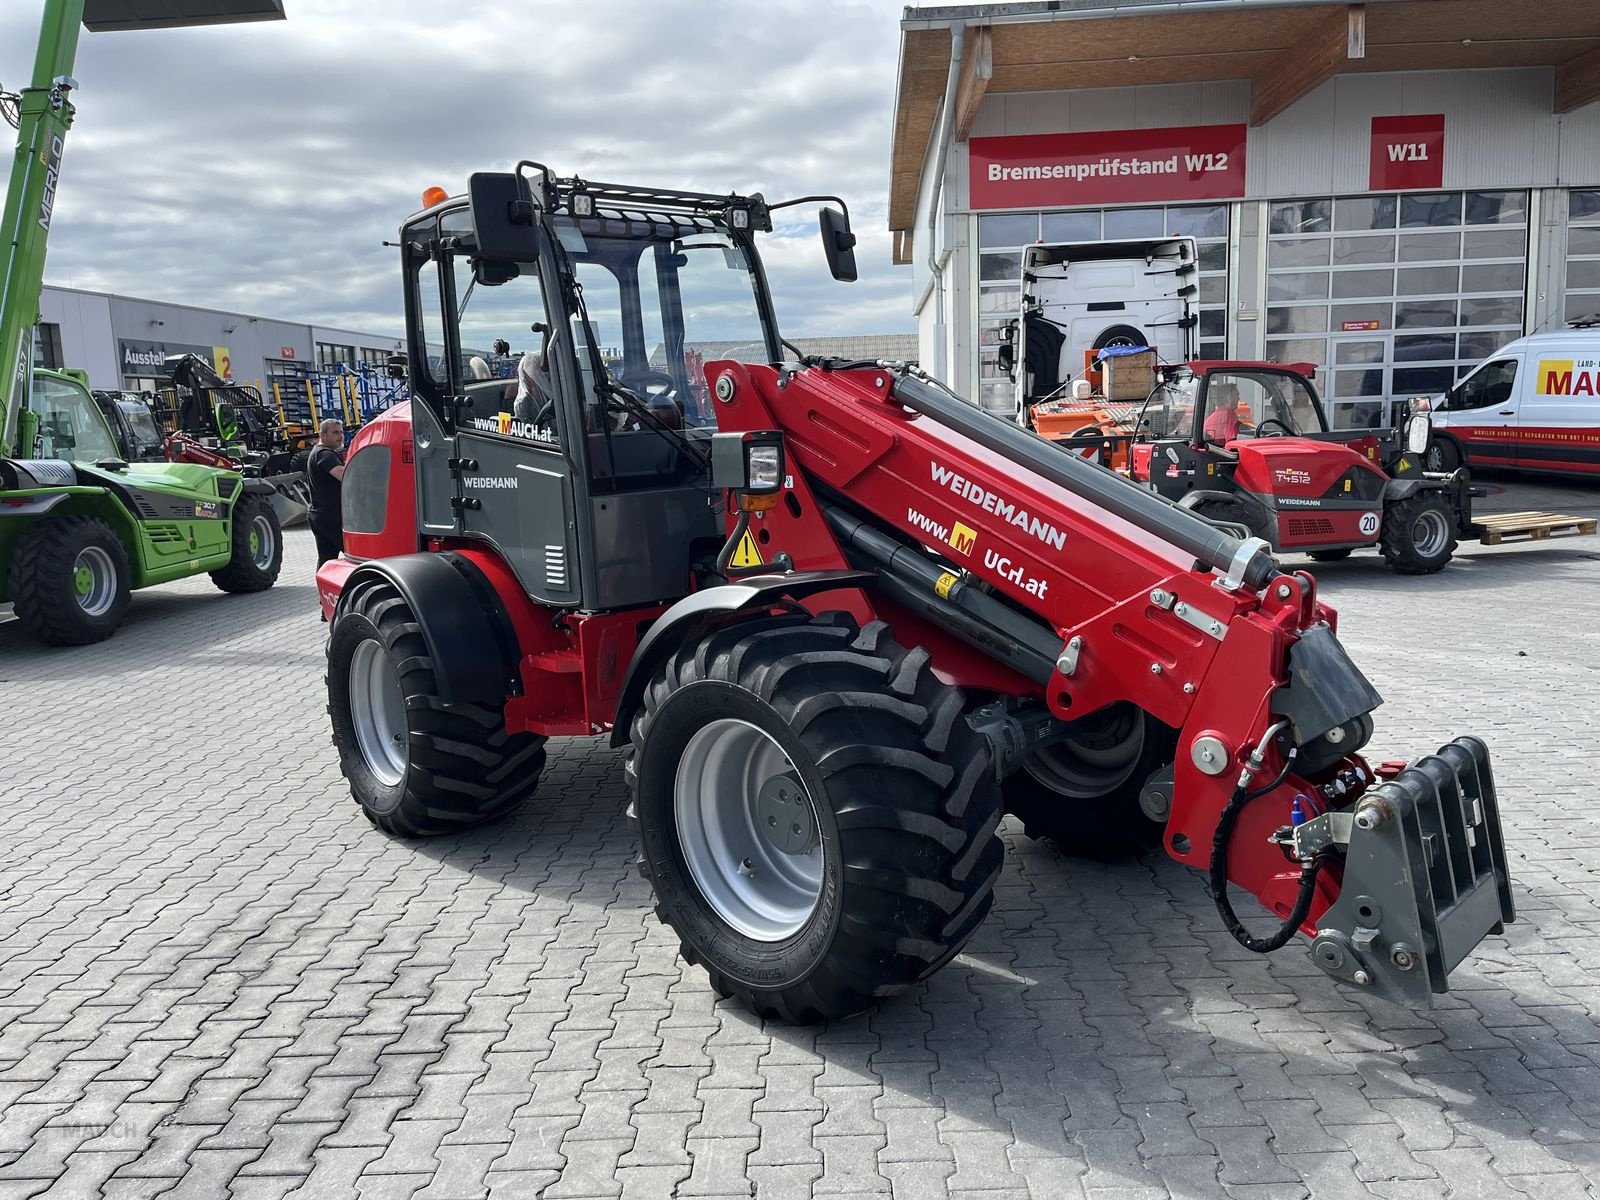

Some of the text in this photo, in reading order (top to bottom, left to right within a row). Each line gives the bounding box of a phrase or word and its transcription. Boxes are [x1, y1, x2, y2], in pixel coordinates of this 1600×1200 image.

[1387, 143, 1428, 162] W11
[988, 153, 1228, 182] Bremsenprüfstand W12
[38, 135, 63, 231] MERLO
[474, 417, 552, 442] www.MAUCH.at
[463, 477, 518, 489] WEIDEMANN
[1277, 475, 1310, 484] T4512
[930, 461, 1067, 551] WEIDEMANN
[1279, 498, 1320, 506] WEIDEMANN
[1363, 517, 1376, 531] 20
